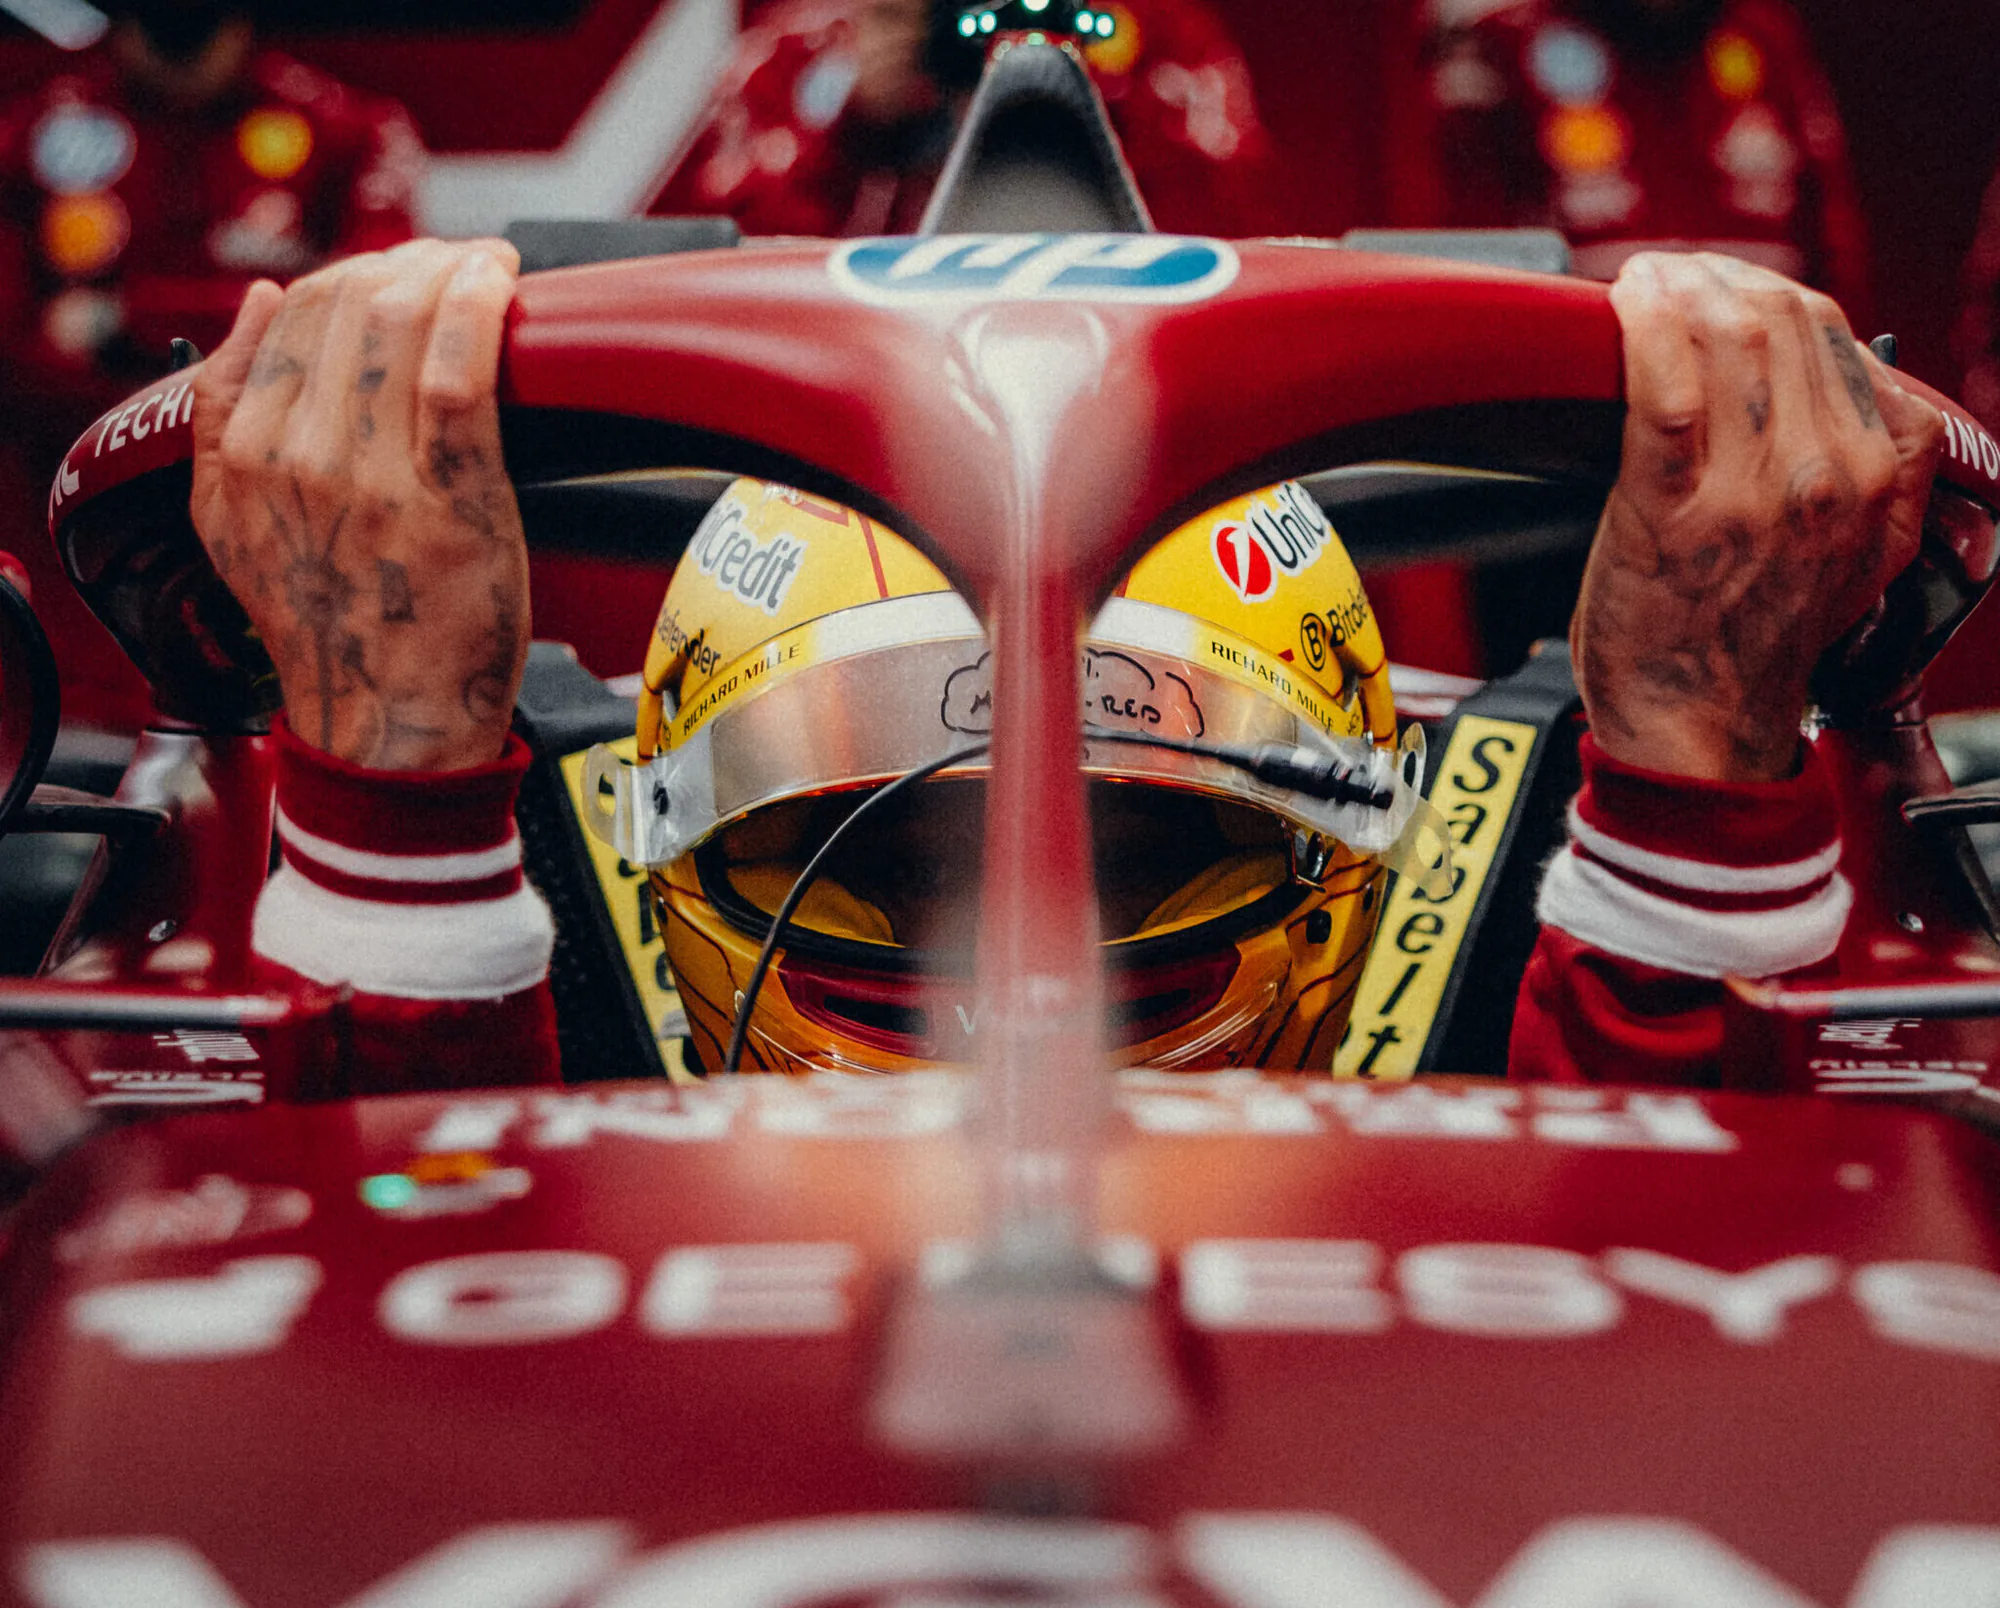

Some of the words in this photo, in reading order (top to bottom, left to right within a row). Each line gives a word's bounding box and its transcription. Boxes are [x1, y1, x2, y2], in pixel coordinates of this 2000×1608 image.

[684, 675, 739, 736] RICHARD
[744, 643, 801, 683] MILLE
[1211, 640, 1292, 696] RICHARD
